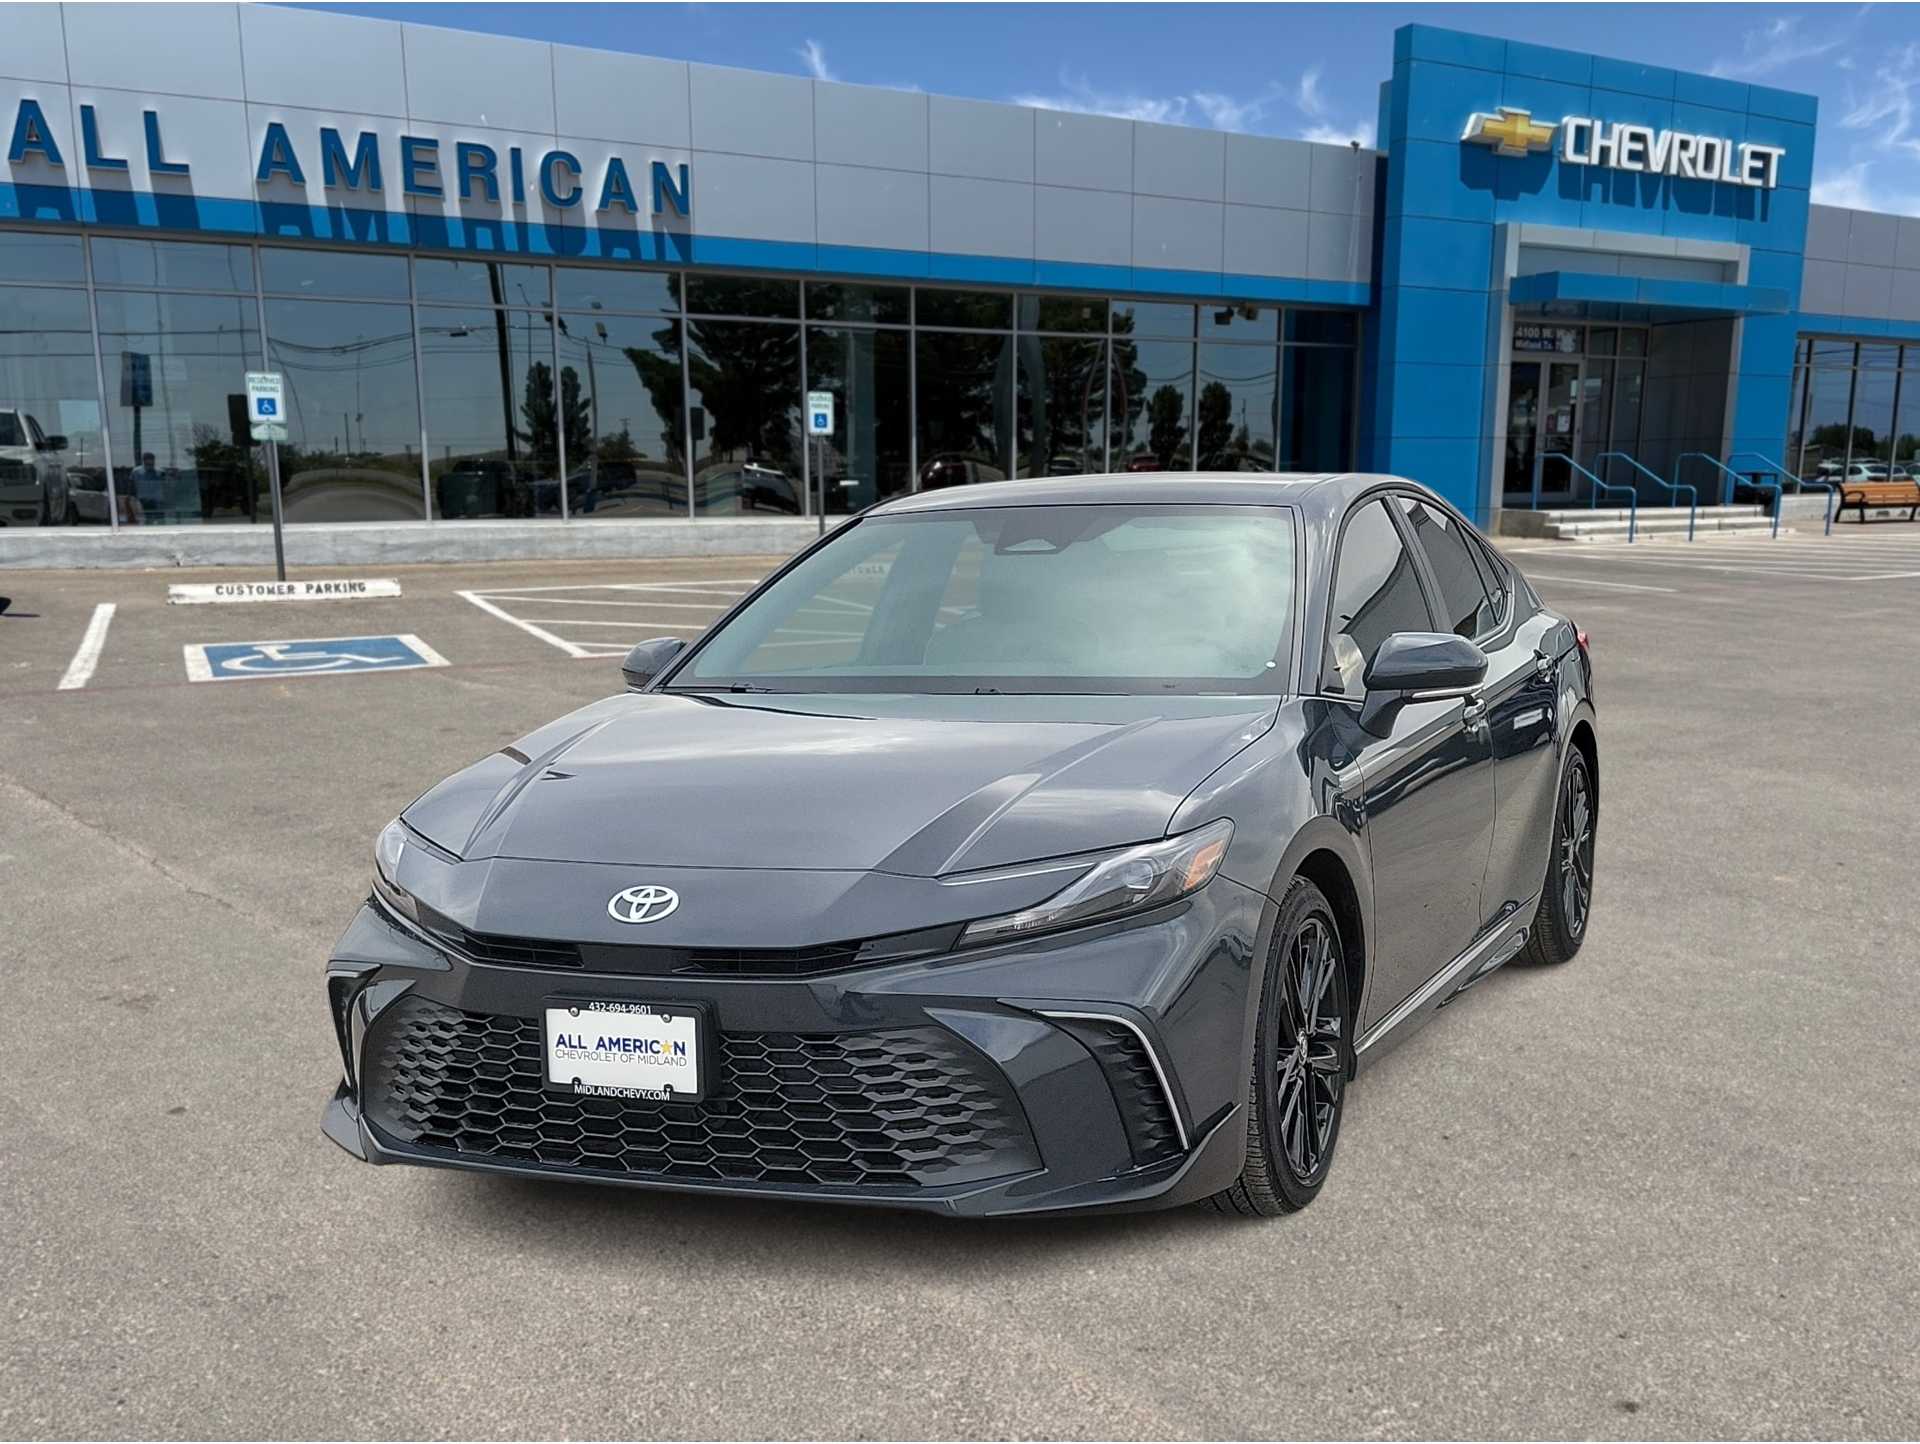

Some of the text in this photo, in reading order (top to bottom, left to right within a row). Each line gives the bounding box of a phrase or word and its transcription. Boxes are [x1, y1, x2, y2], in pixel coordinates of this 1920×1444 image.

[8, 99, 691, 217] ALL AMERICAN
[1561, 115, 1786, 188] CHEVROLET
[251, 385, 279, 393] PARKING
[215, 582, 367, 596] CUSTOMER PARKING
[588, 1002, 652, 1015] 432-694-9601
[555, 1034, 686, 1056] ALL AMERICN
[555, 1049, 687, 1067] CHEVROLET OF MIDLAND
[574, 1084, 670, 1101] MIDLANDCHEVY.COM
